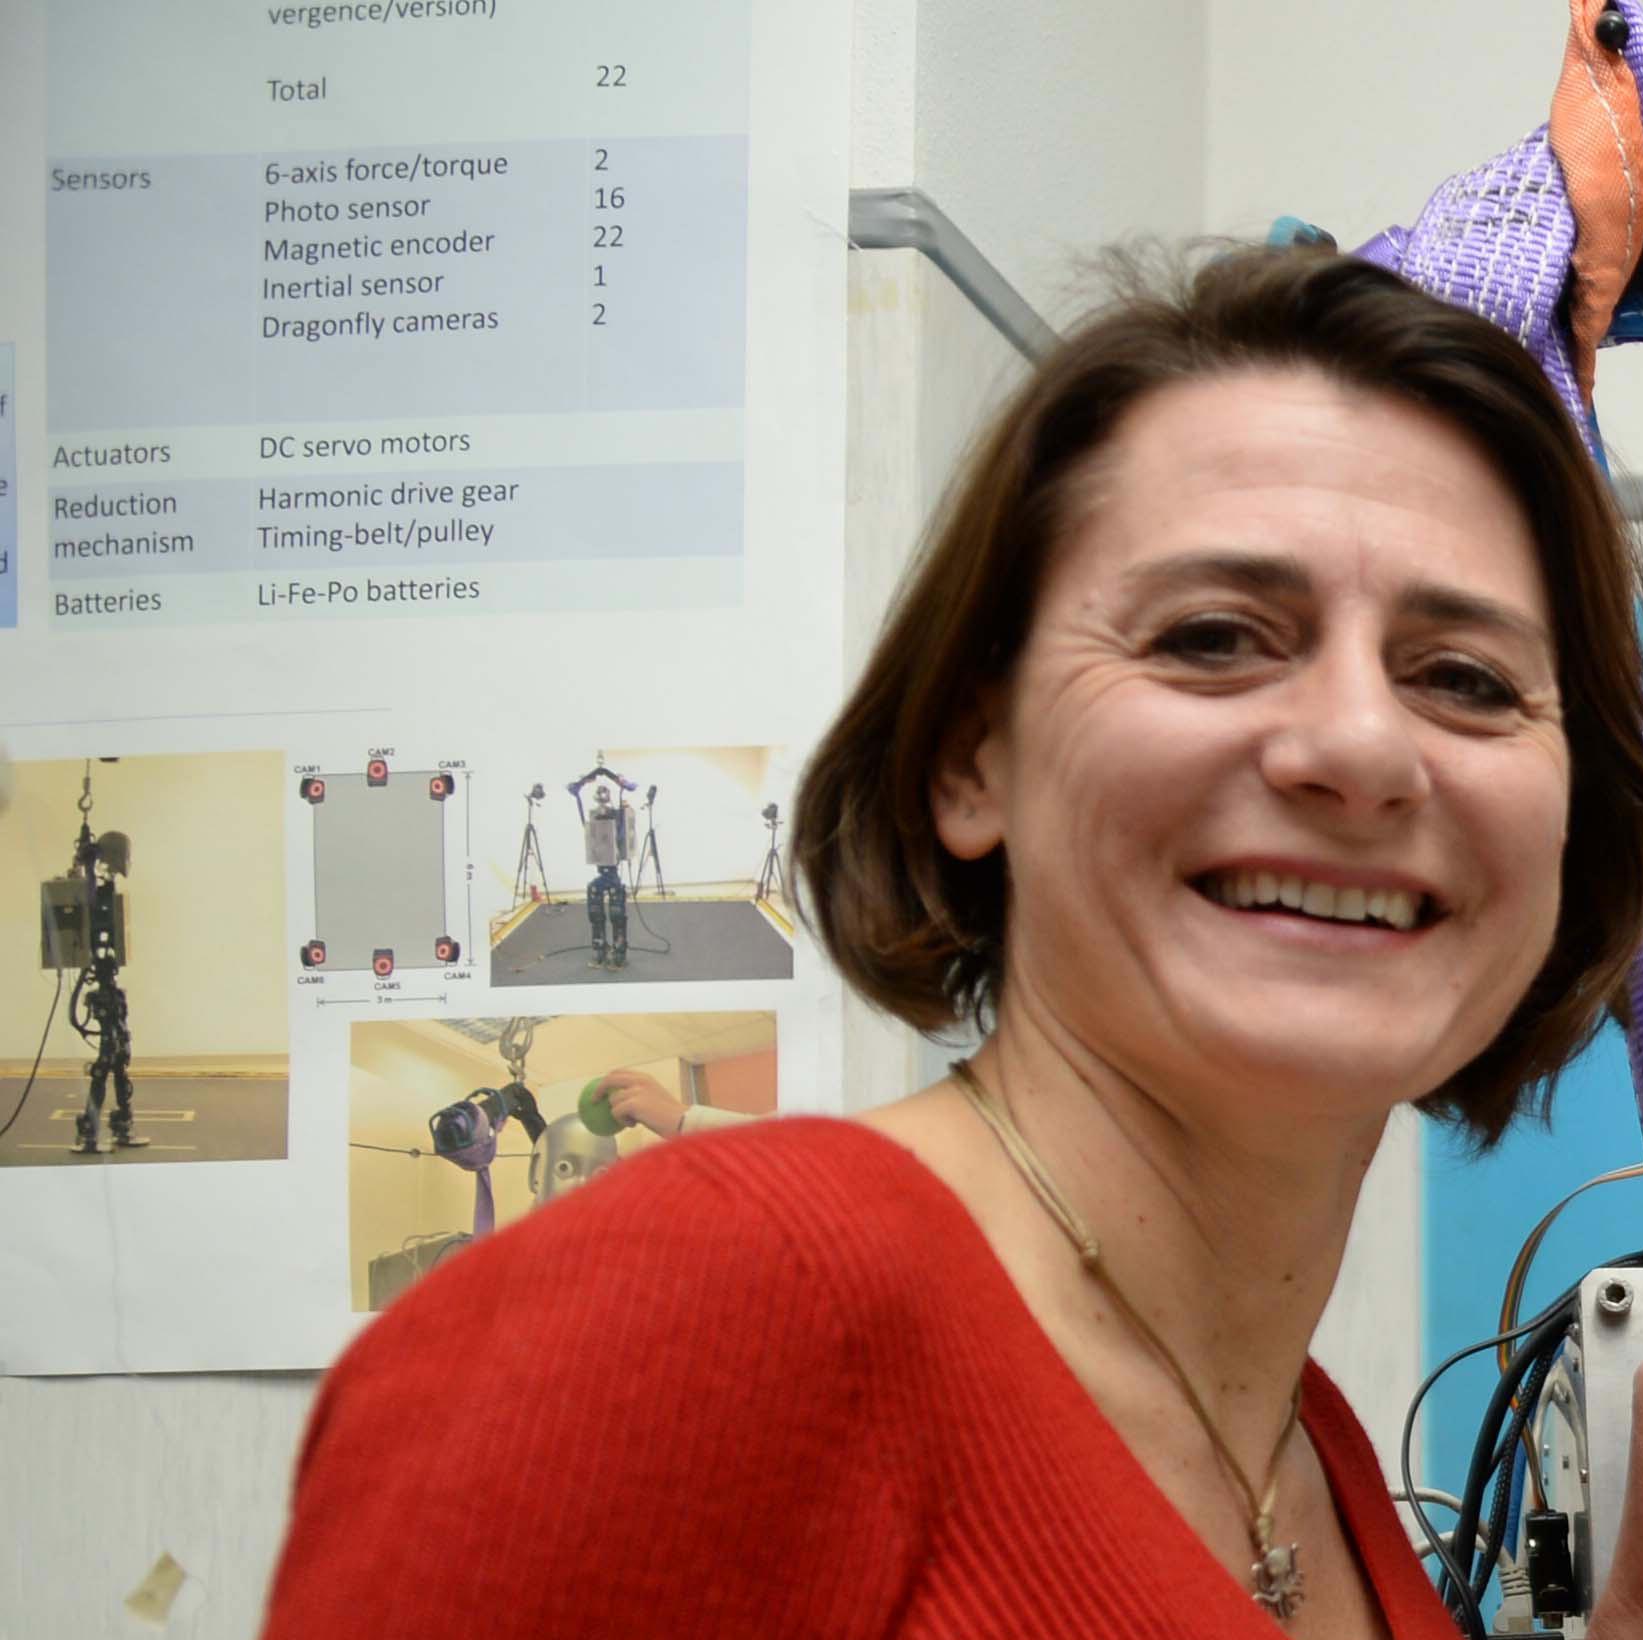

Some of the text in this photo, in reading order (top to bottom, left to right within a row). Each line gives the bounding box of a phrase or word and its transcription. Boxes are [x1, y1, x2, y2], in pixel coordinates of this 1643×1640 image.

[268, 0, 496, 29] vergence/version)
[267, 76, 326, 101] Total
[597, 65, 626, 87] 22
[266, 153, 508, 185] 6-axis force/torque
[595, 149, 608, 170] 2
[50, 166, 151, 192] Sensors
[265, 198, 431, 222] Photo sensor
[596, 187, 624, 209] 16
[265, 230, 495, 265] Magnetic encoder
[593, 225, 623, 247] 22
[264, 274, 444, 299] Inertial sensor
[594, 265, 606, 286] 1
[263, 311, 499, 342] Dragonfly cameras
[593, 303, 606, 325] 2
[53, 444, 171, 468] Actuators
[261, 433, 470, 459] DC servo motors
[55, 492, 176, 520] Reduction
[260, 481, 519, 510] Harmonic drive gear
[55, 531, 193, 558] mechanism
[257, 519, 494, 552] Timing-belt/pulley
[56, 589, 161, 616] Batteries
[259, 577, 479, 606] Li-Fe-Po batteries
[367, 748, 395, 758] CAM2
[438, 760, 466, 769] CAM3
[294, 765, 321, 774] CAM1
